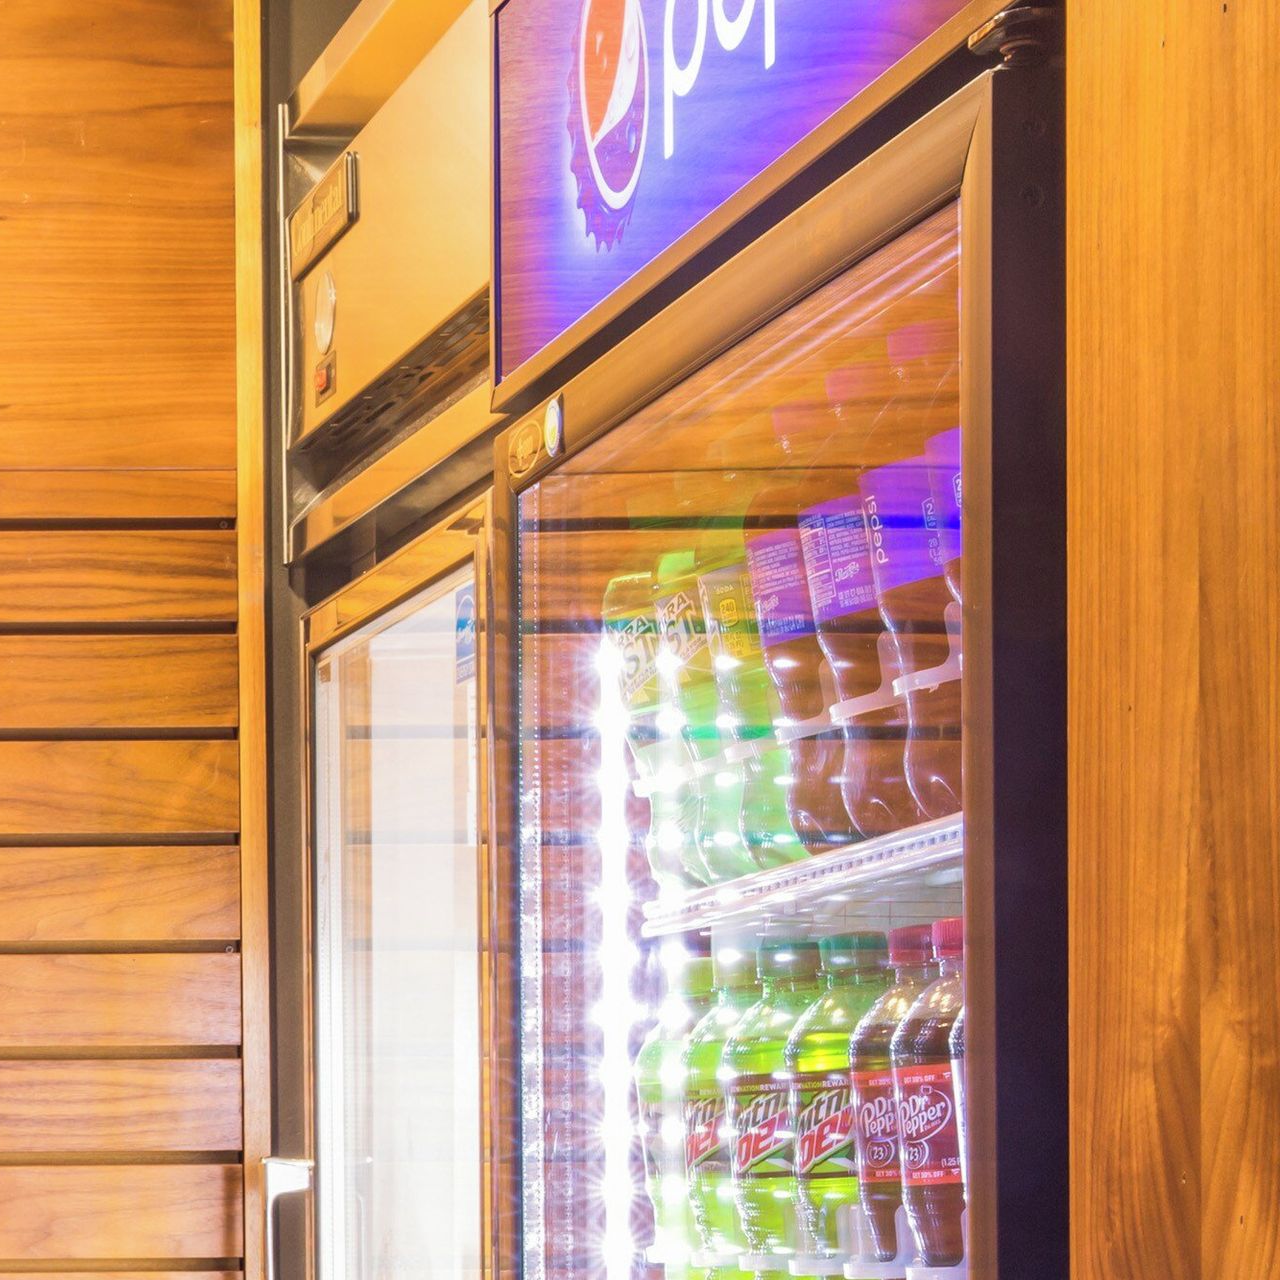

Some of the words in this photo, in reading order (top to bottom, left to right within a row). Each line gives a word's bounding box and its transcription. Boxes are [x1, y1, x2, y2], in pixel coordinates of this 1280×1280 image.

[865, 494, 889, 565] pepsi
[861, 1102, 898, 1139] Pepp
[900, 1100, 946, 1139] Pepper
[872, 1146, 884, 1160] 23
[909, 1147, 920, 1161] 23
